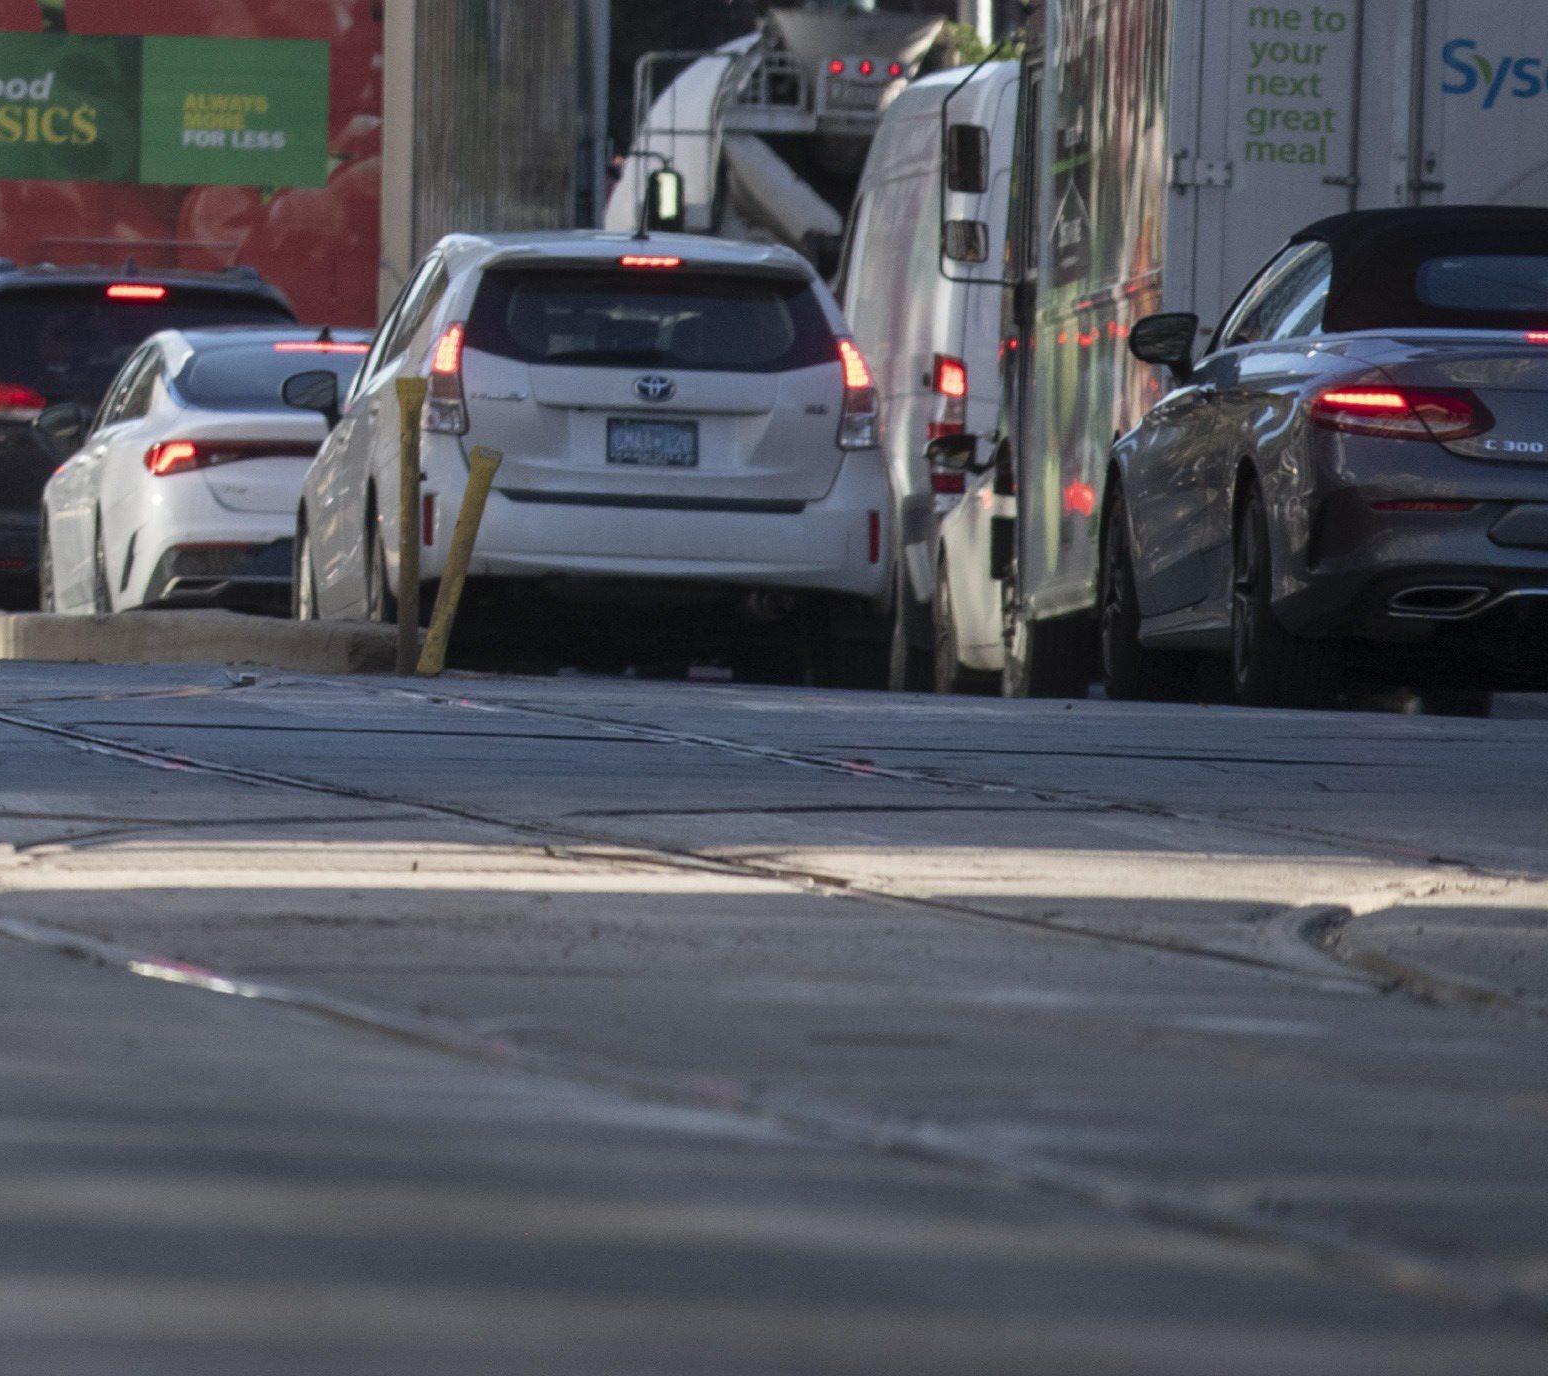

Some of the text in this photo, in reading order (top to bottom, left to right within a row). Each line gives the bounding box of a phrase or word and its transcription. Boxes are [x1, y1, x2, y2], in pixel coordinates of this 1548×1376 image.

[1248, 6, 1346, 32] me to
[1249, 41, 1328, 69] your
[1245, 74, 1323, 98] next
[1441, 38, 1548, 109] Sys
[185, 93, 268, 113] ALWAYS
[184, 112, 246, 130] MORE
[1245, 107, 1336, 136] great
[183, 129, 286, 150] FOR LESS
[1244, 136, 1328, 166] meal
[1502, 440, 1544, 453] 300
